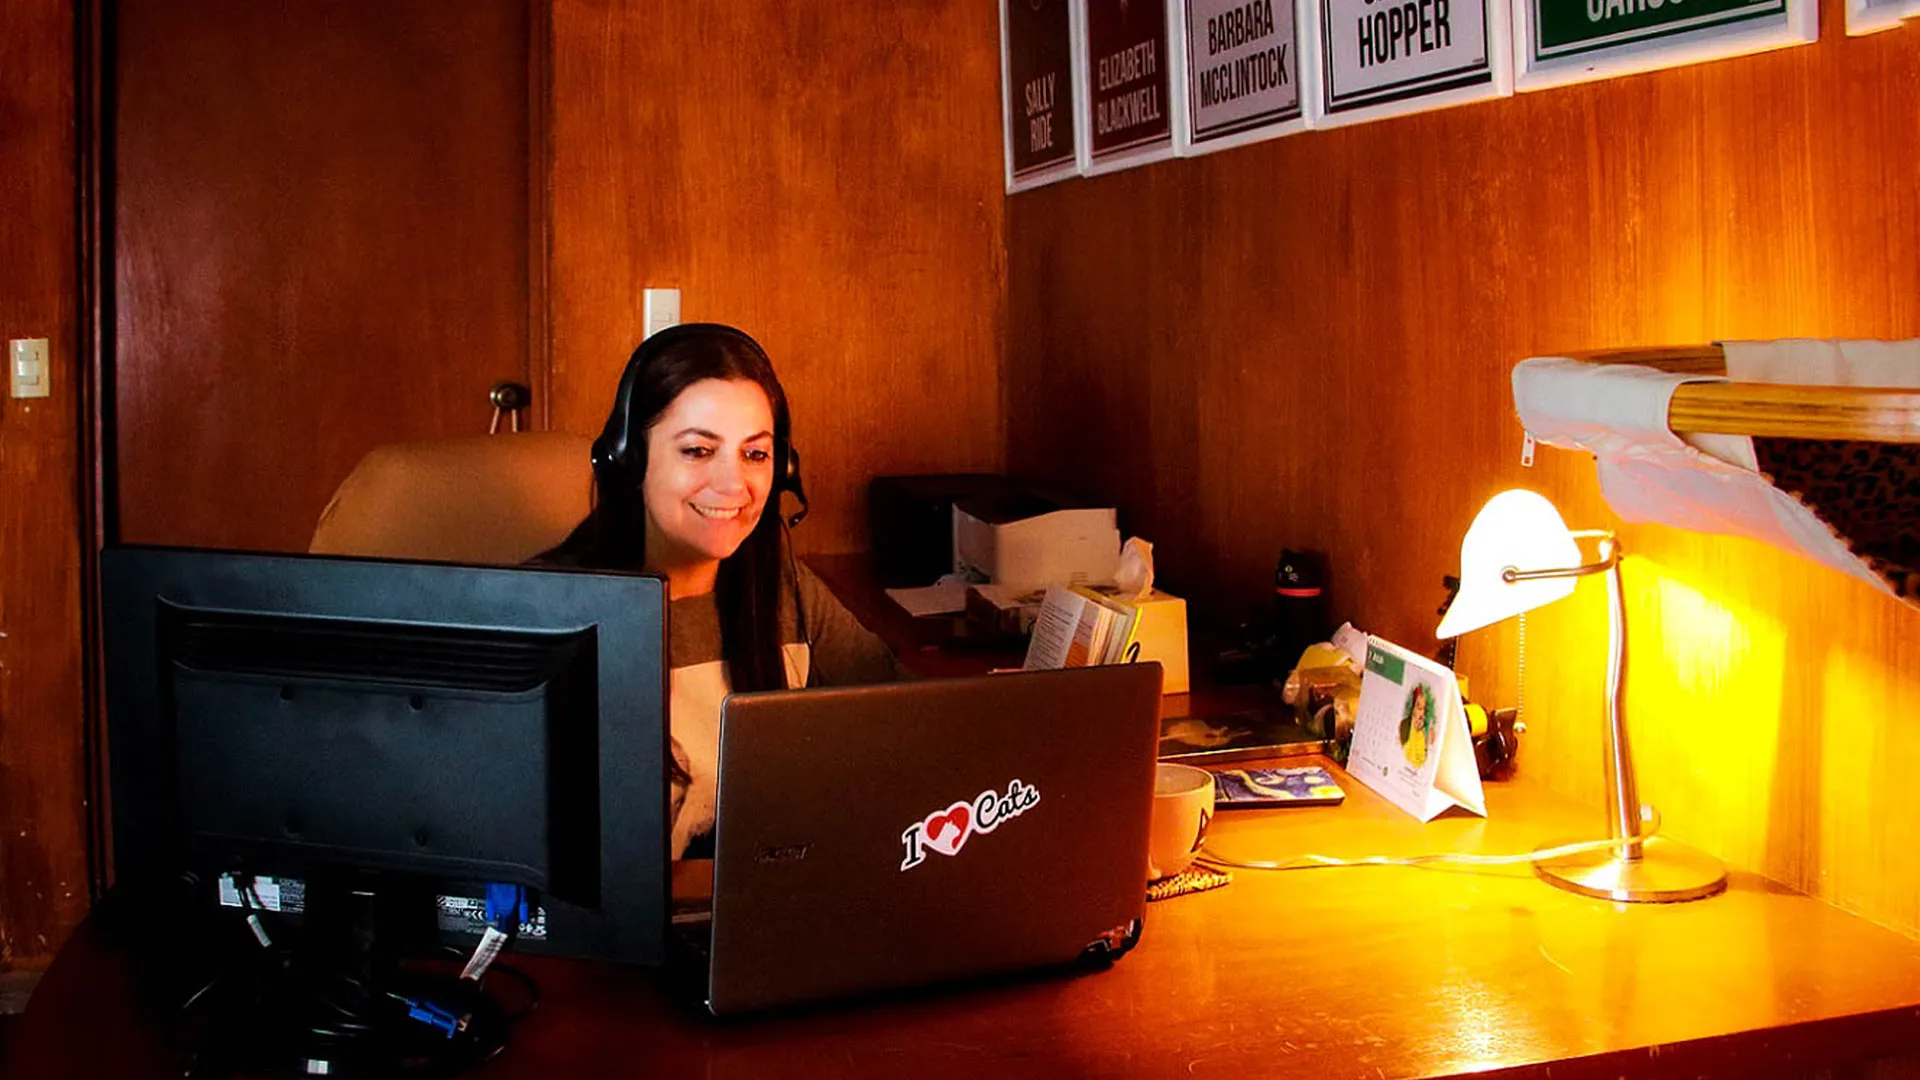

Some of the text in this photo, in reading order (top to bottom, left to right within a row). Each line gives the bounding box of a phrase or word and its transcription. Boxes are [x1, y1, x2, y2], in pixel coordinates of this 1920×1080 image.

[1208, 0, 1274, 56] BARBARA
[1358, 0, 1451, 68] HOPPER
[1099, 40, 1156, 91] ELIZABETH
[1200, 43, 1288, 108] MCCLINTOCK
[1025, 72, 1055, 116] SALLY
[1098, 84, 1160, 135] BLACKWELL
[1030, 113, 1053, 152] RIDE
[904, 782, 1038, 866] I Cats
